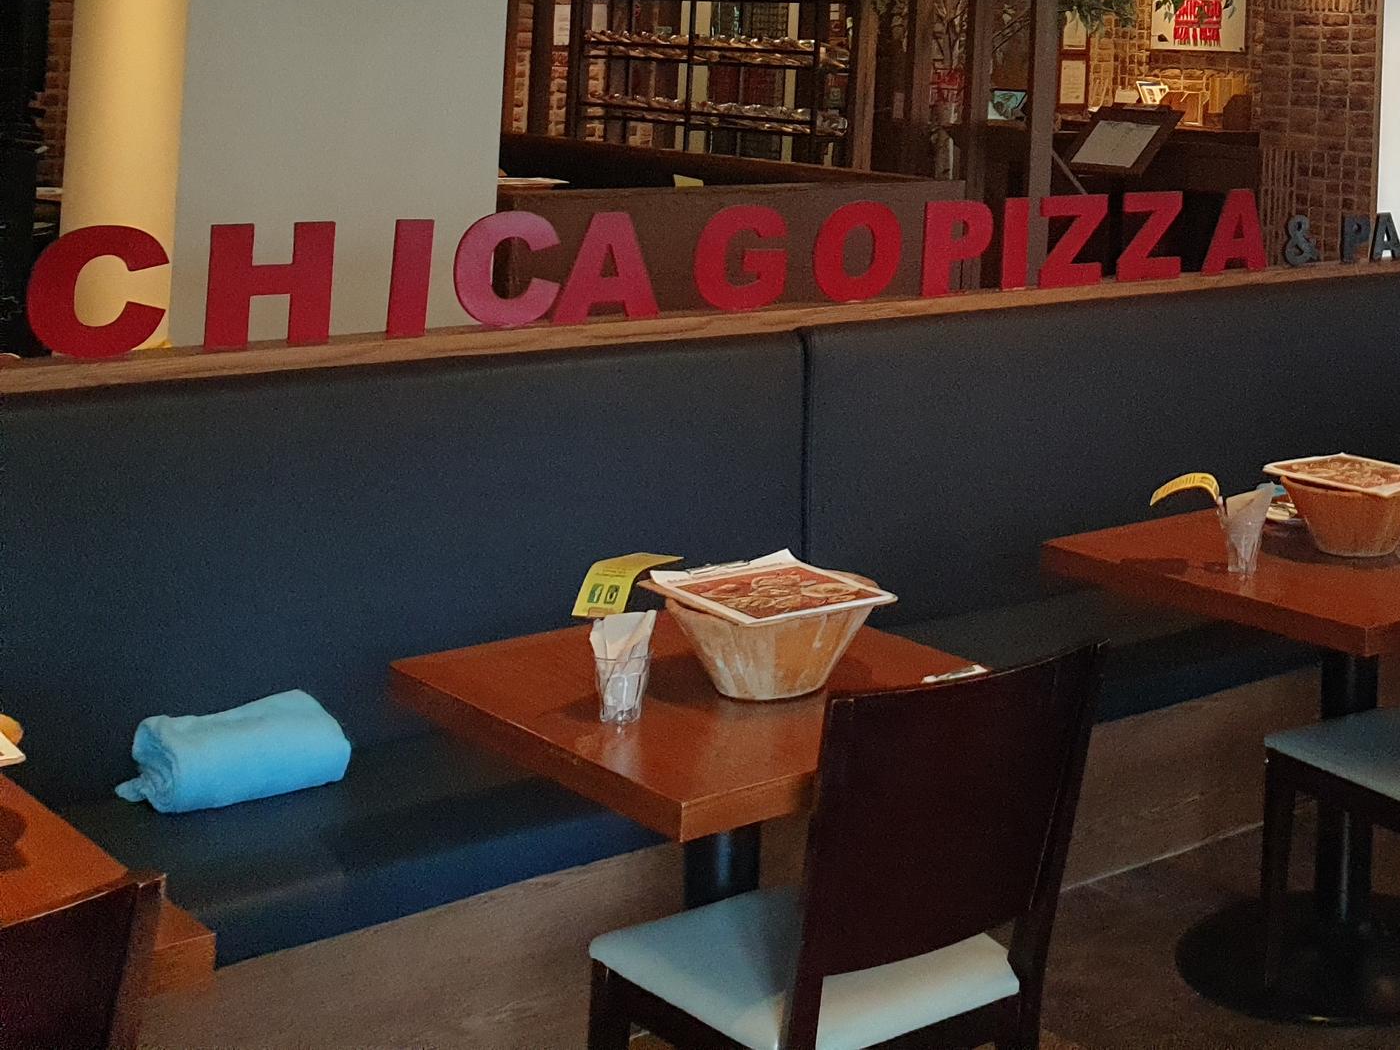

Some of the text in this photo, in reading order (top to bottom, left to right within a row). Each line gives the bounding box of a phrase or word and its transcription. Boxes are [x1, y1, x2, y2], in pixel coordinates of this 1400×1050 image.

[26, 201, 903, 359] CHICAGO
[921, 188, 1268, 297] PIZZA
[1285, 214, 1320, 266] &
